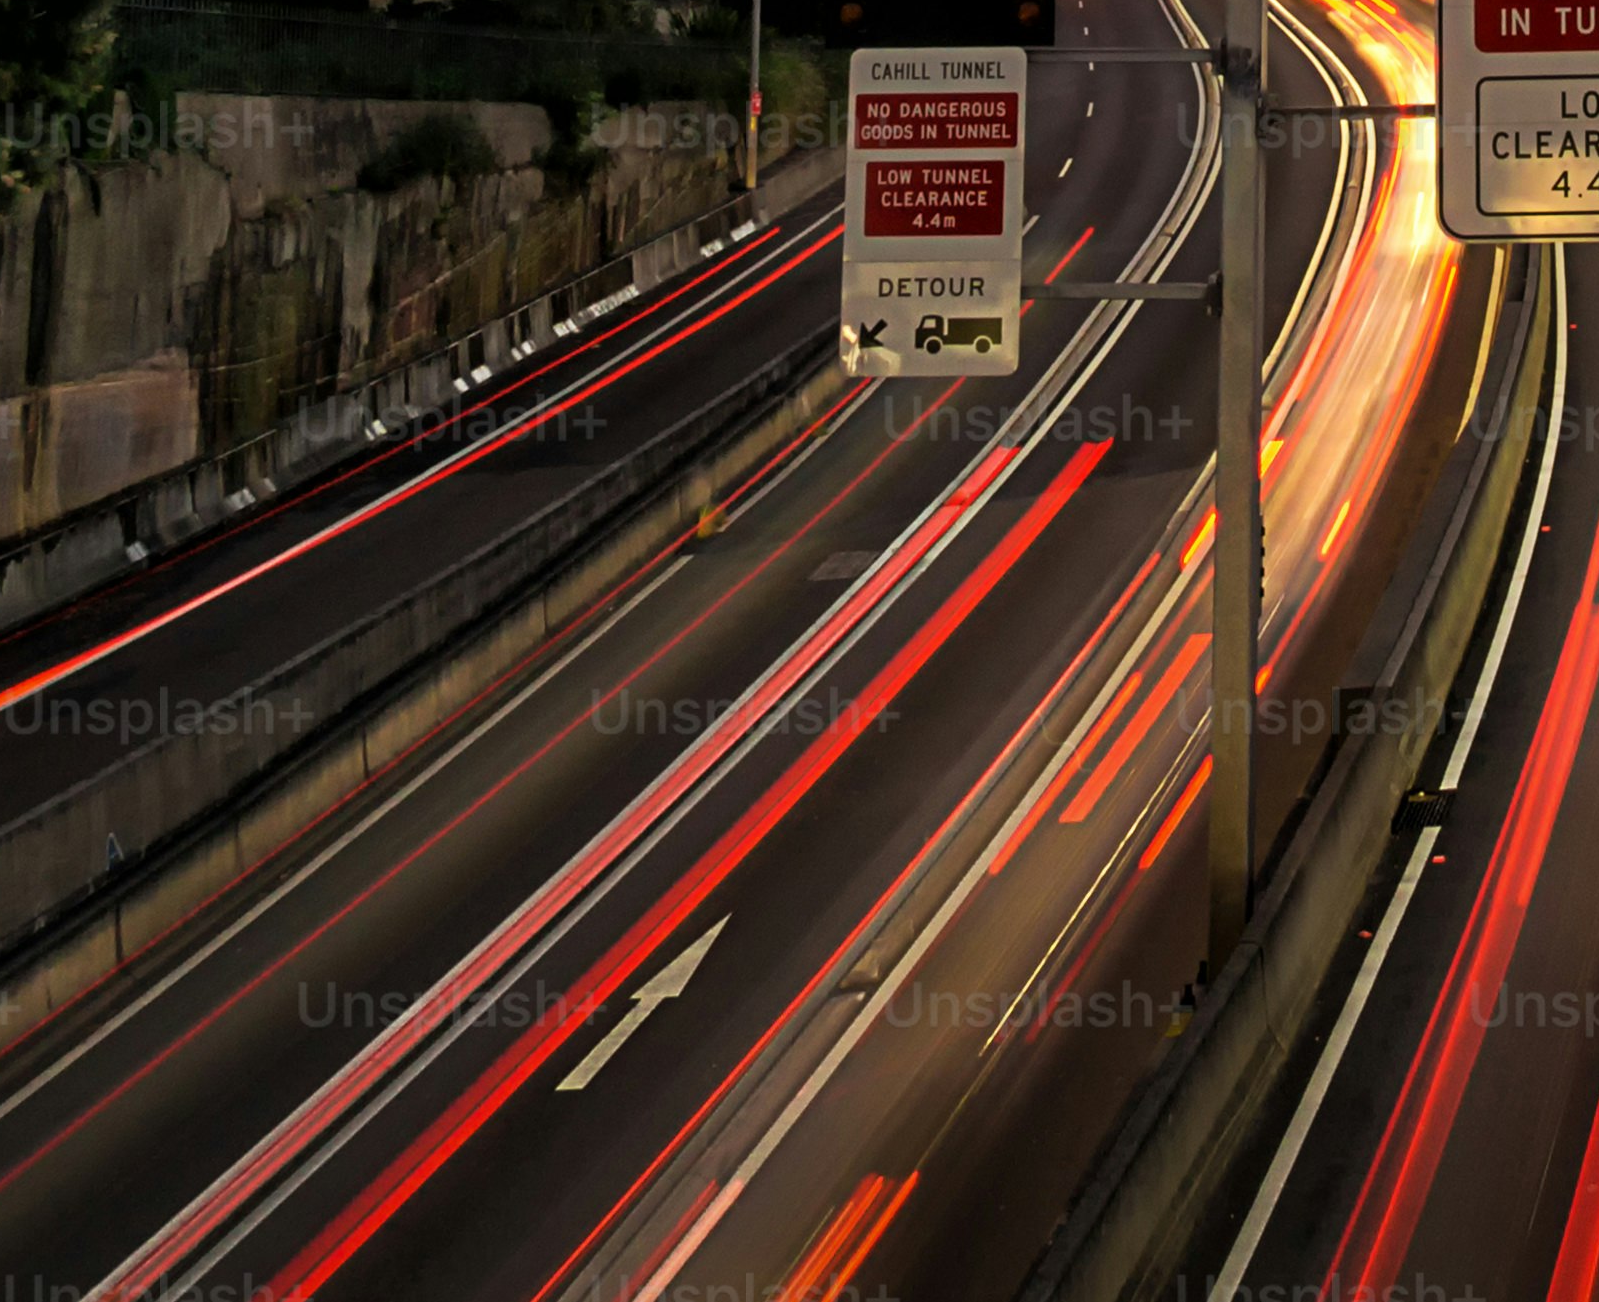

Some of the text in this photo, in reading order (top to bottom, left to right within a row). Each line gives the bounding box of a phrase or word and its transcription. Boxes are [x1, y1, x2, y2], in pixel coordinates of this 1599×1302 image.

[1500, 7, 1531, 36] IN
[871, 61, 1006, 81] CAHILL TUNNEL
[867, 101, 1007, 118] NO DANGEROUS
[860, 123, 1011, 141] GOODS IN TUNNEL
[877, 168, 993, 185] LOW TUNNEL
[881, 190, 988, 208] CLEARANCE
[912, 212, 956, 229] 4.4m
[878, 277, 985, 298] DETOUR
